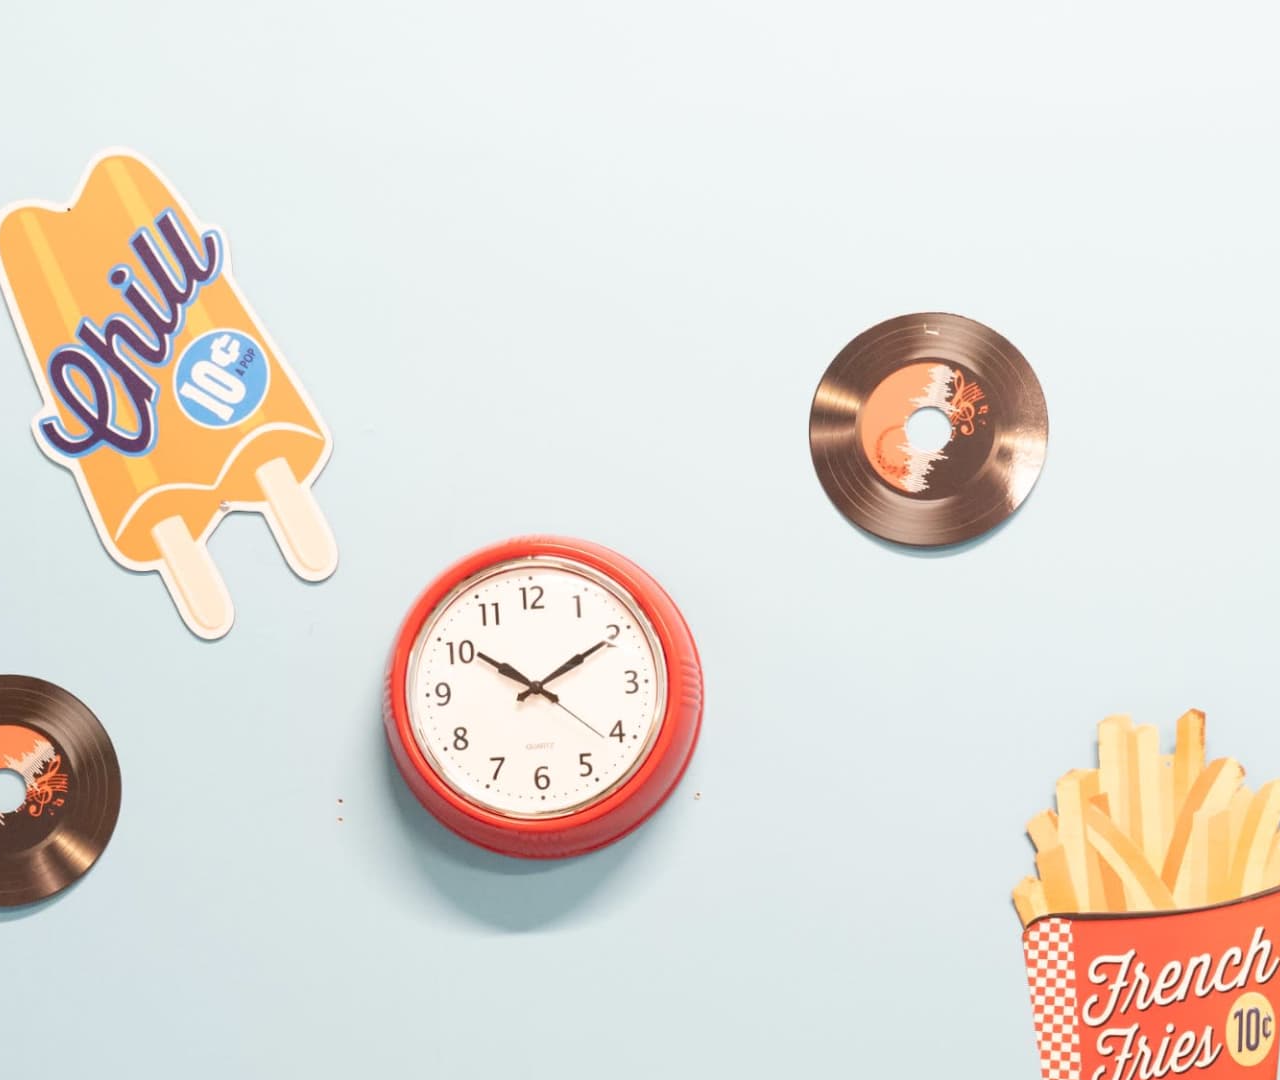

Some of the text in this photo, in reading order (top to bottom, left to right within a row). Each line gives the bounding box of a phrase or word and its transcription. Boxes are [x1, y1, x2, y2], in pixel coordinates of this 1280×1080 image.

[41, 209, 222, 456] Chill
[240, 348, 256, 369] POP
[180, 334, 246, 422] 10¢
[519, 585, 545, 610] 12
[573, 595, 582, 618] 1
[479, 602, 500, 626] 11
[606, 624, 620, 648] 2
[446, 640, 475, 664] 10
[435, 682, 451, 706] 9
[624, 670, 639, 694] 3
[453, 727, 469, 750] 8
[609, 720, 625, 743] 4
[490, 757, 505, 780] 7
[579, 753, 593, 777] 5
[534, 766, 551, 790] 6
[1233, 1007, 1272, 1053] 10¢
